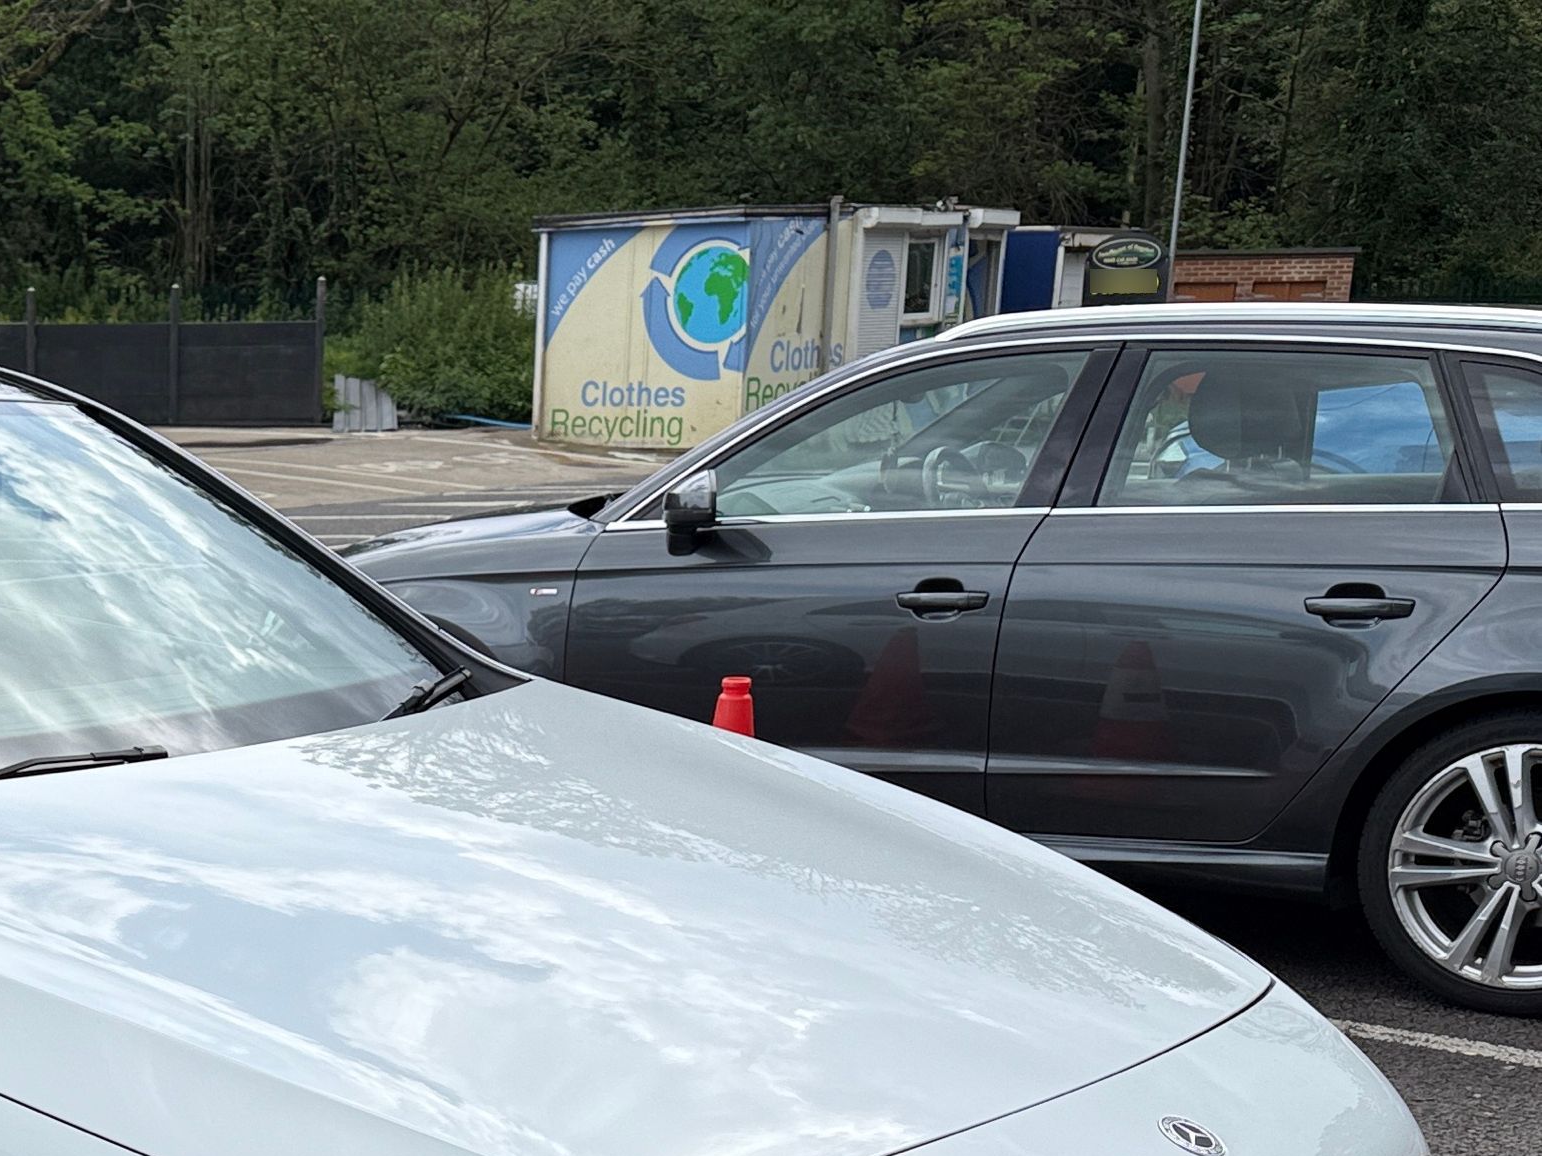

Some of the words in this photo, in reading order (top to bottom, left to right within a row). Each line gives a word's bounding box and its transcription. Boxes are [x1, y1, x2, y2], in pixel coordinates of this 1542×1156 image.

[550, 293, 570, 316] we
[566, 266, 587, 297] pay
[586, 238, 616, 270] cash
[581, 380, 686, 407] Clothes
[550, 408, 684, 446] Recycling
